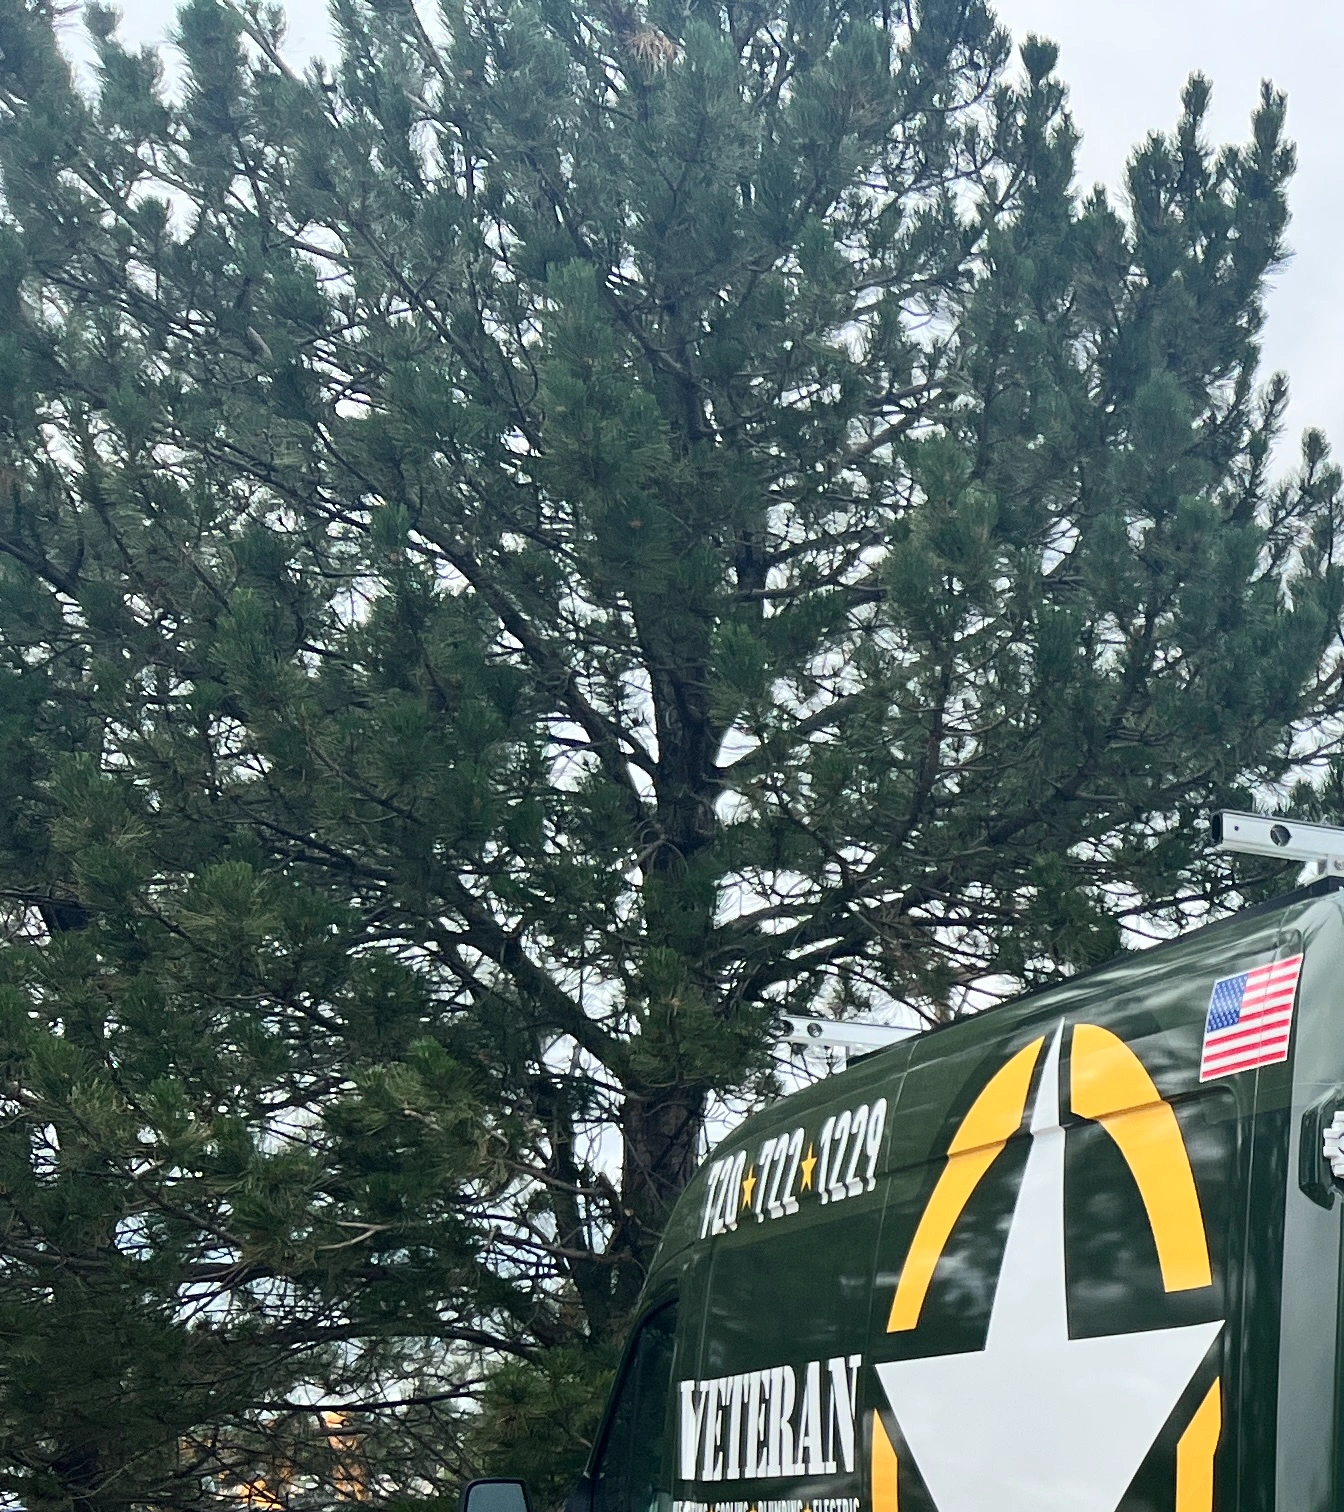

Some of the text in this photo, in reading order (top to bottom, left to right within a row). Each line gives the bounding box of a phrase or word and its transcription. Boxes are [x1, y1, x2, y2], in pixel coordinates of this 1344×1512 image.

[700, 1098, 888, 1240] 720 722 1229
[680, 1354, 862, 1482] VETERAN
